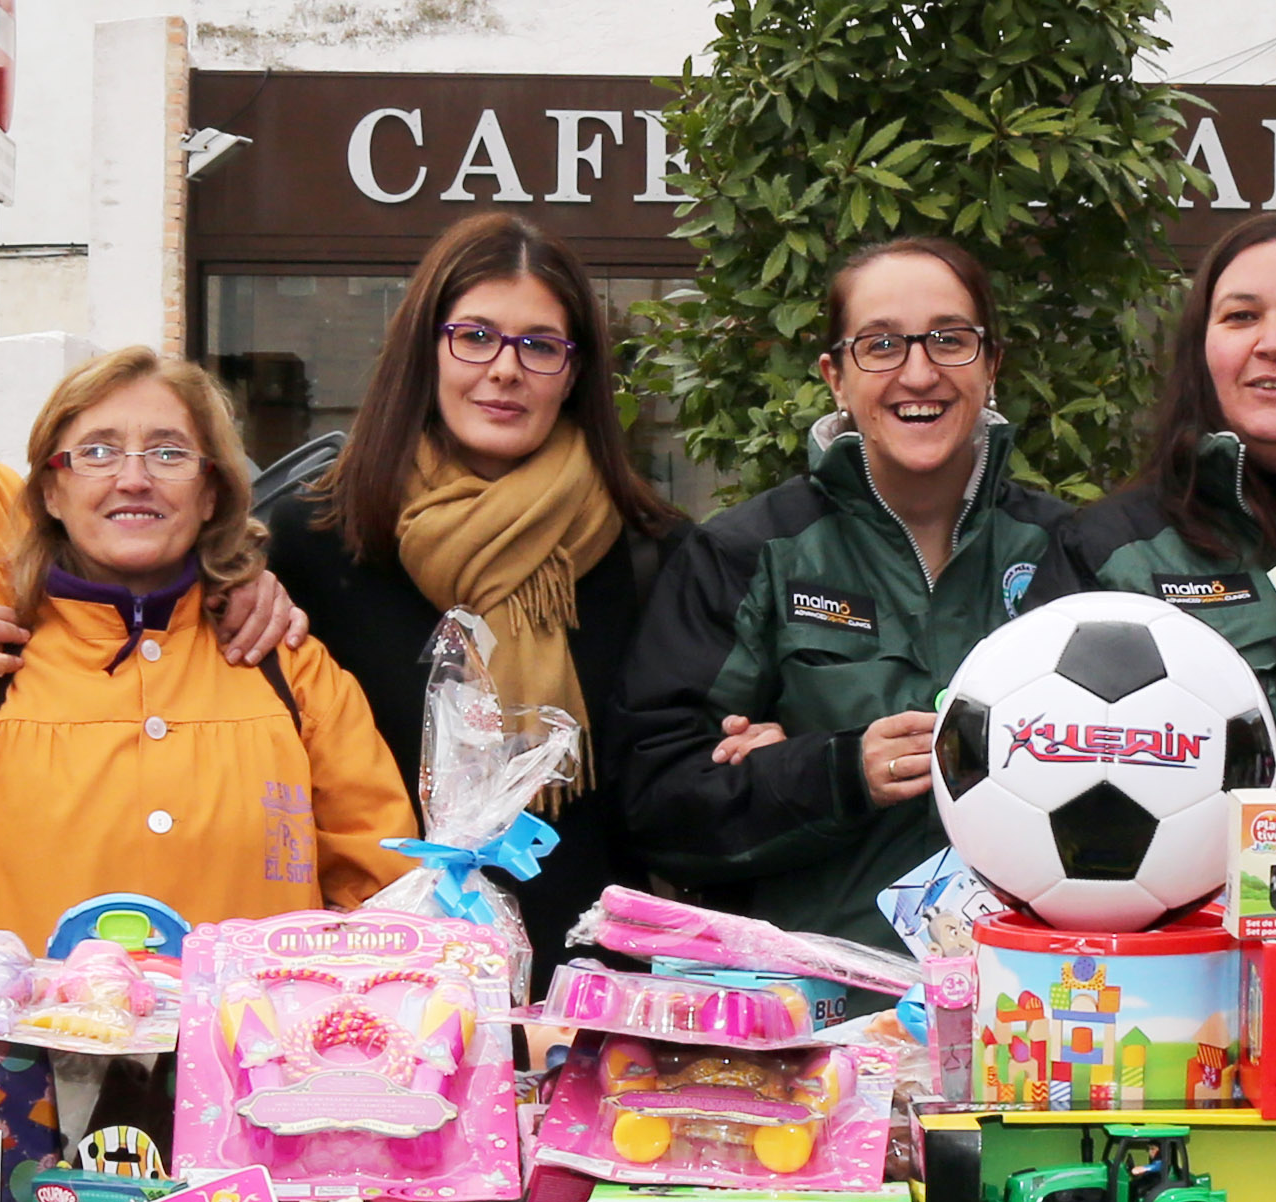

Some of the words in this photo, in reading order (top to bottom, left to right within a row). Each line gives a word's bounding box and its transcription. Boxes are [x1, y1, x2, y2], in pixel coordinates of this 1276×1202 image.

[1162, 580, 1225, 595] malmö
[793, 592, 851, 615] malmö
[1246, 920, 1260, 928] Set
[1246, 928, 1260, 936] Set
[276, 933, 340, 951] JUMP
[347, 932, 407, 950] ROPE
